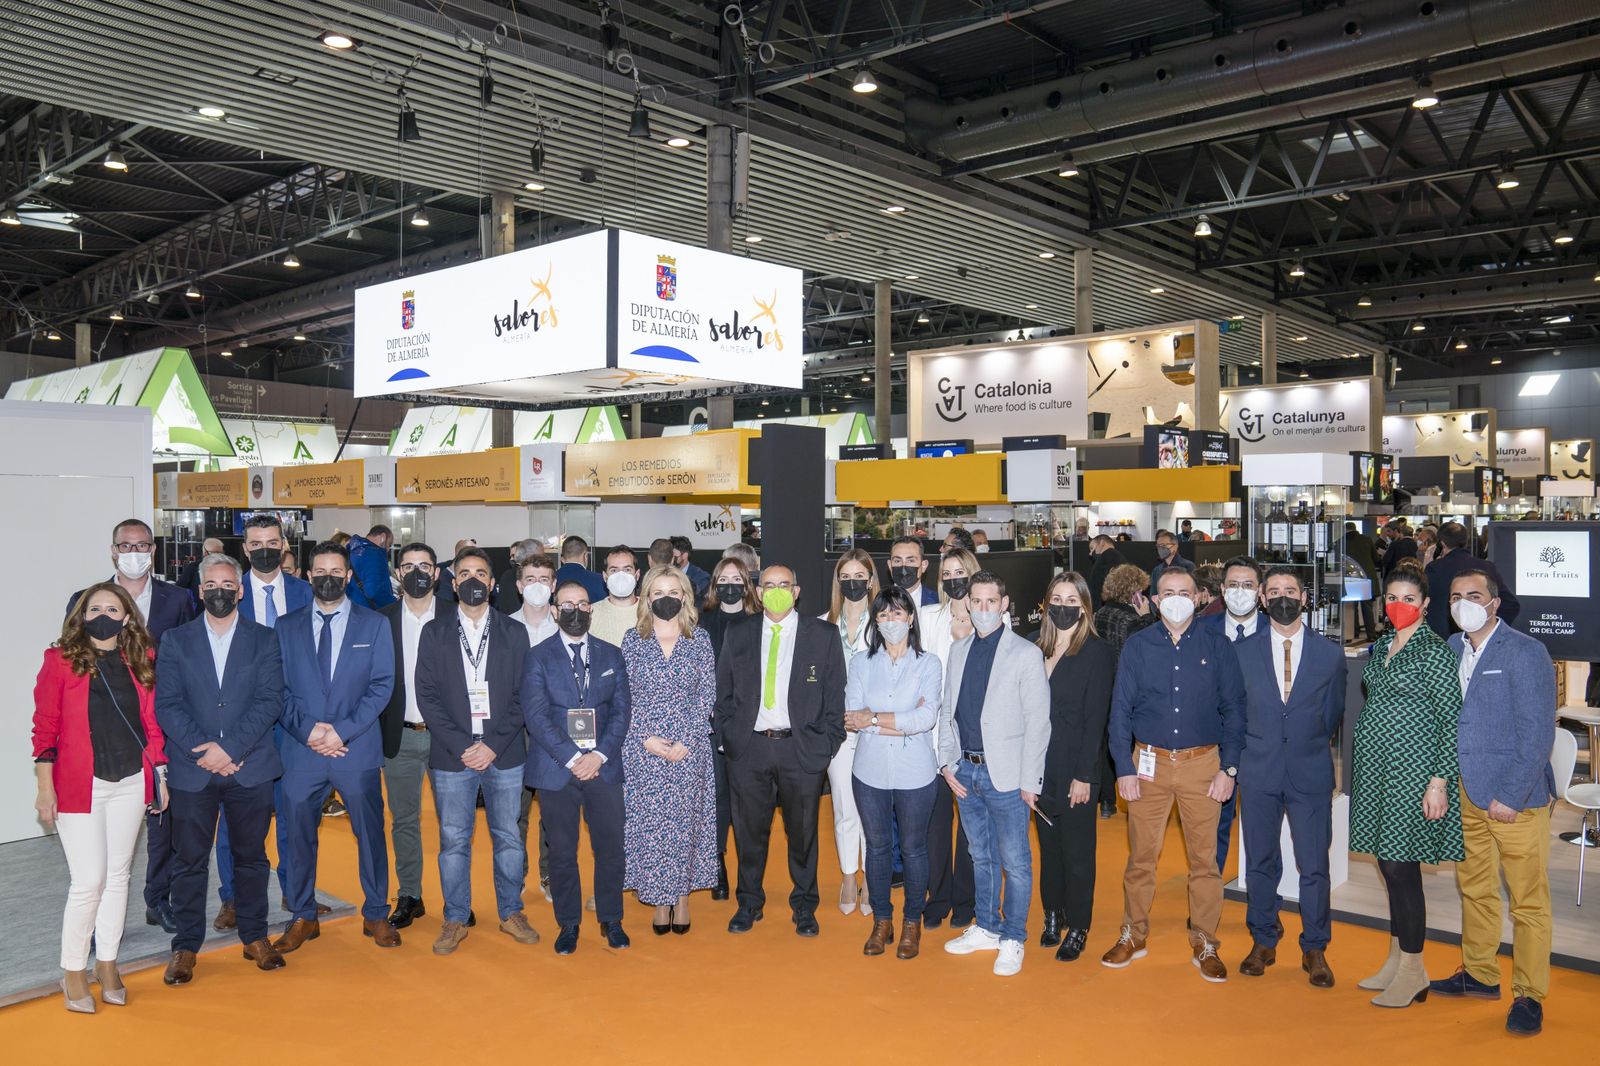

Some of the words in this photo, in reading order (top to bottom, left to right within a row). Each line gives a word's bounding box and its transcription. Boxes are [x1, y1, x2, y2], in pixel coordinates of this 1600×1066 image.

[631, 302, 700, 325] DIPUTACIÓN
[632, 319, 647, 333] DE
[650, 322, 698, 341] ALMERÍA
[386, 332, 431, 350] DIPUTACIÓN
[387, 352, 396, 363] DE
[399, 345, 429, 361] ALMERÍA
[975, 379, 1052, 398] Catalonia
[975, 403, 1003, 413] Where
[1005, 402, 1026, 411] food
[1028, 401, 1036, 410] is
[1039, 400, 1072, 410] culture
[1272, 411, 1345, 424] Catalunya
[1272, 428, 1284, 436] On
[1296, 427, 1322, 436] menjar
[1337, 424, 1366, 433] cultura
[621, 460, 637, 472] LOS
[640, 458, 681, 471] REMEDIOS
[294, 477, 317, 487] JAMONES
[317, 477, 324, 486] DE
[324, 474, 342, 485] SERÓN
[425, 476, 453, 489] SERONÉS
[454, 476, 490, 488] ARTESANO
[608, 475, 653, 487] EMBUTIDOS
[656, 474, 665, 485] de
[667, 472, 696, 485] SERÓN
[1057, 475, 1070, 487] SUN
[309, 490, 325, 498] CHECA
[1552, 570, 1579, 579] fruits
